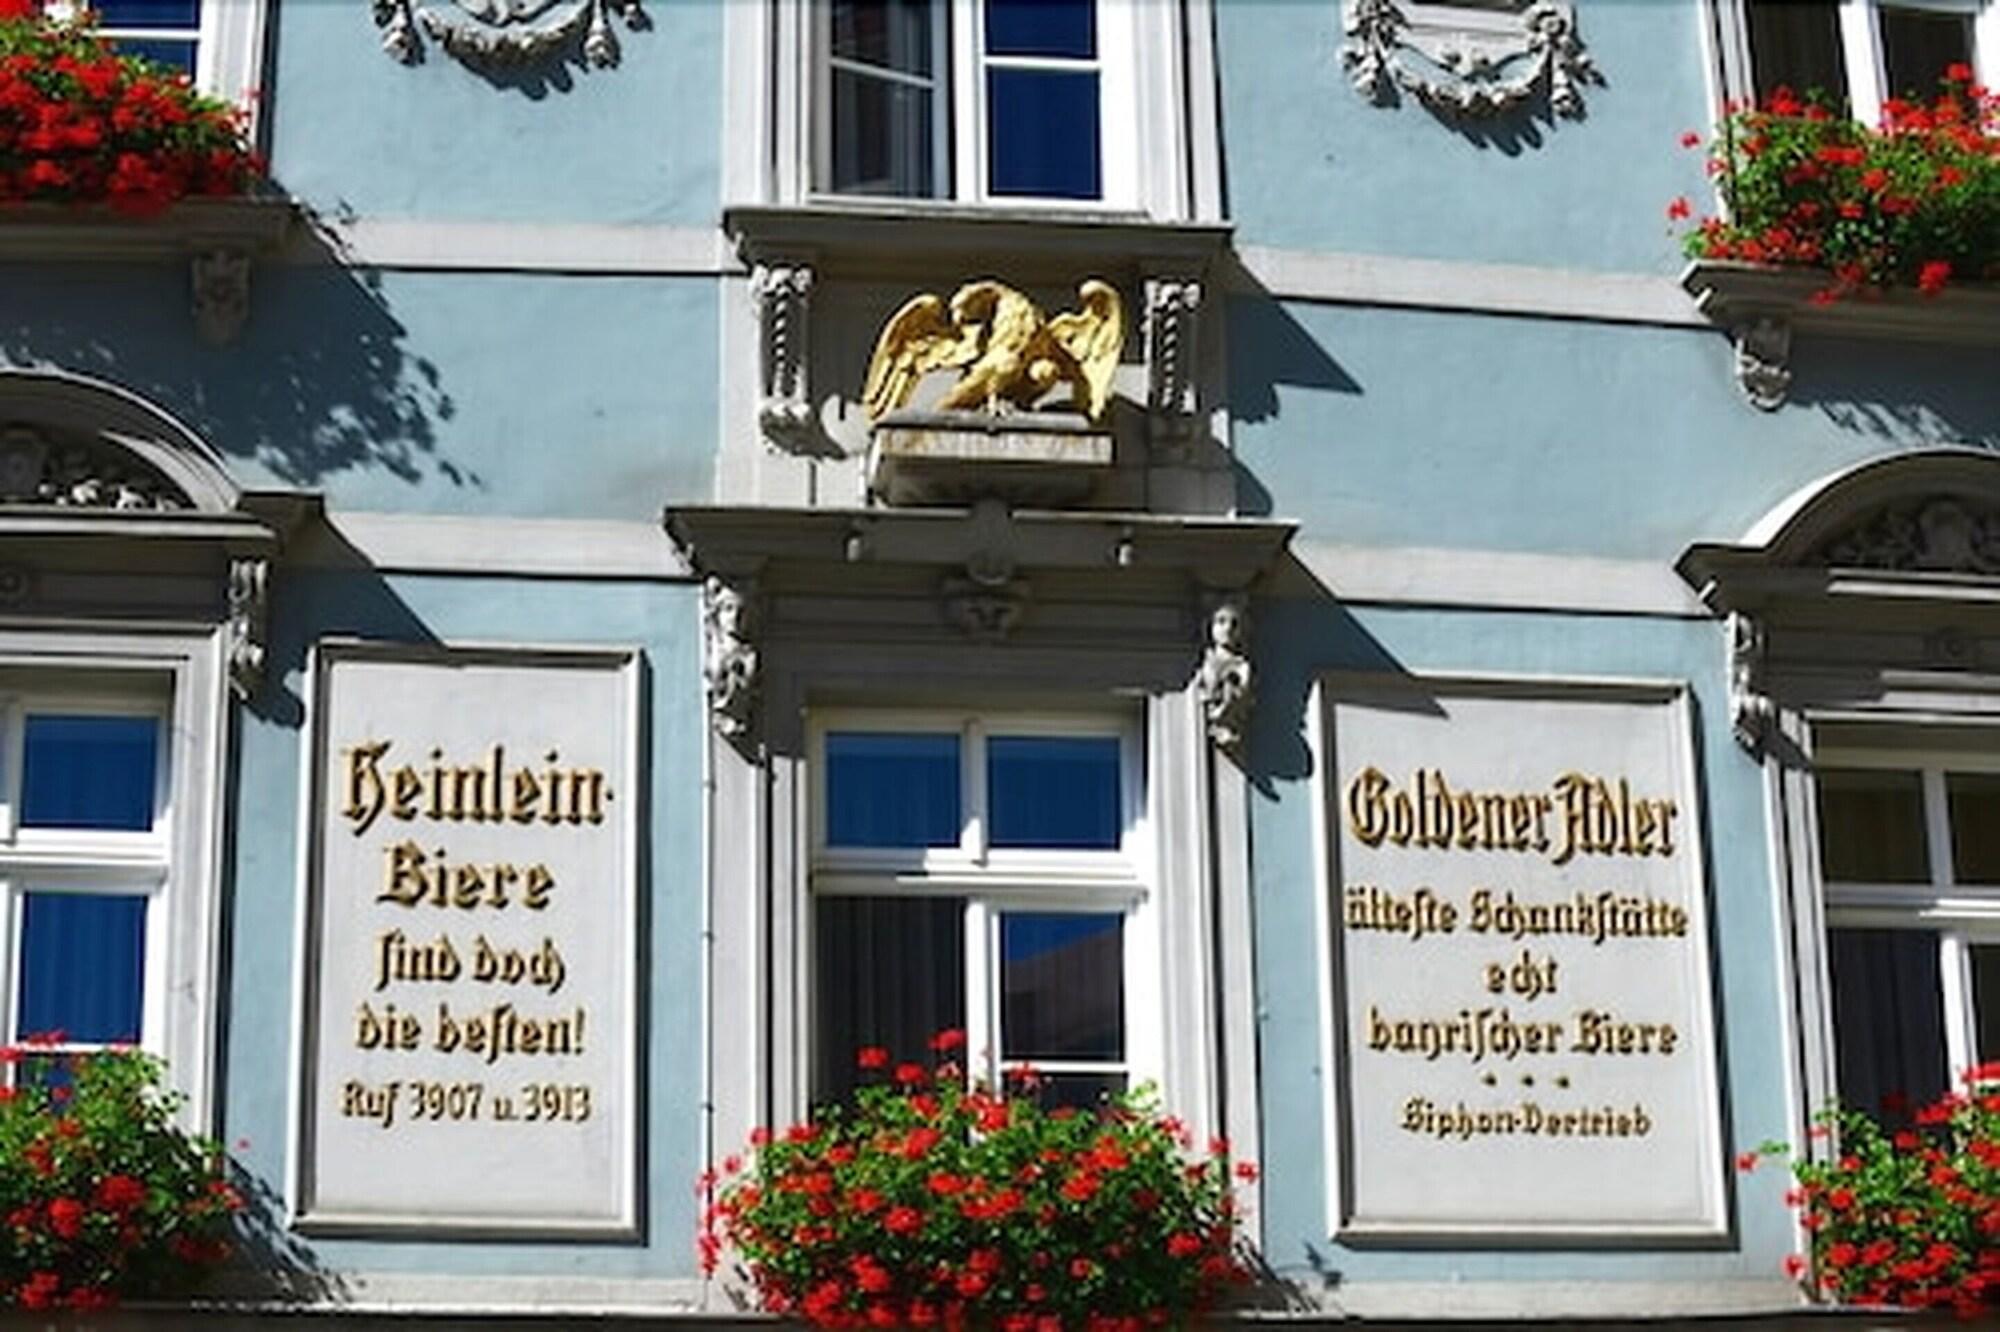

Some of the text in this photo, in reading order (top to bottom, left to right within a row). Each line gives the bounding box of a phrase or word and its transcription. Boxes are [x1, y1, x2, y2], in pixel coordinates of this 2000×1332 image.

[1347, 766, 1678, 867] Goldener Adler
[375, 840, 555, 911] Biere
[471, 935, 566, 995] doch
[1486, 948, 1558, 1002] echt
[356, 1002, 423, 1051] die
[1570, 1009, 1678, 1056] Biere
[341, 1080, 400, 1129] Ruf
[408, 1081, 483, 1121] 3907
[521, 1083, 591, 1122] 3913
